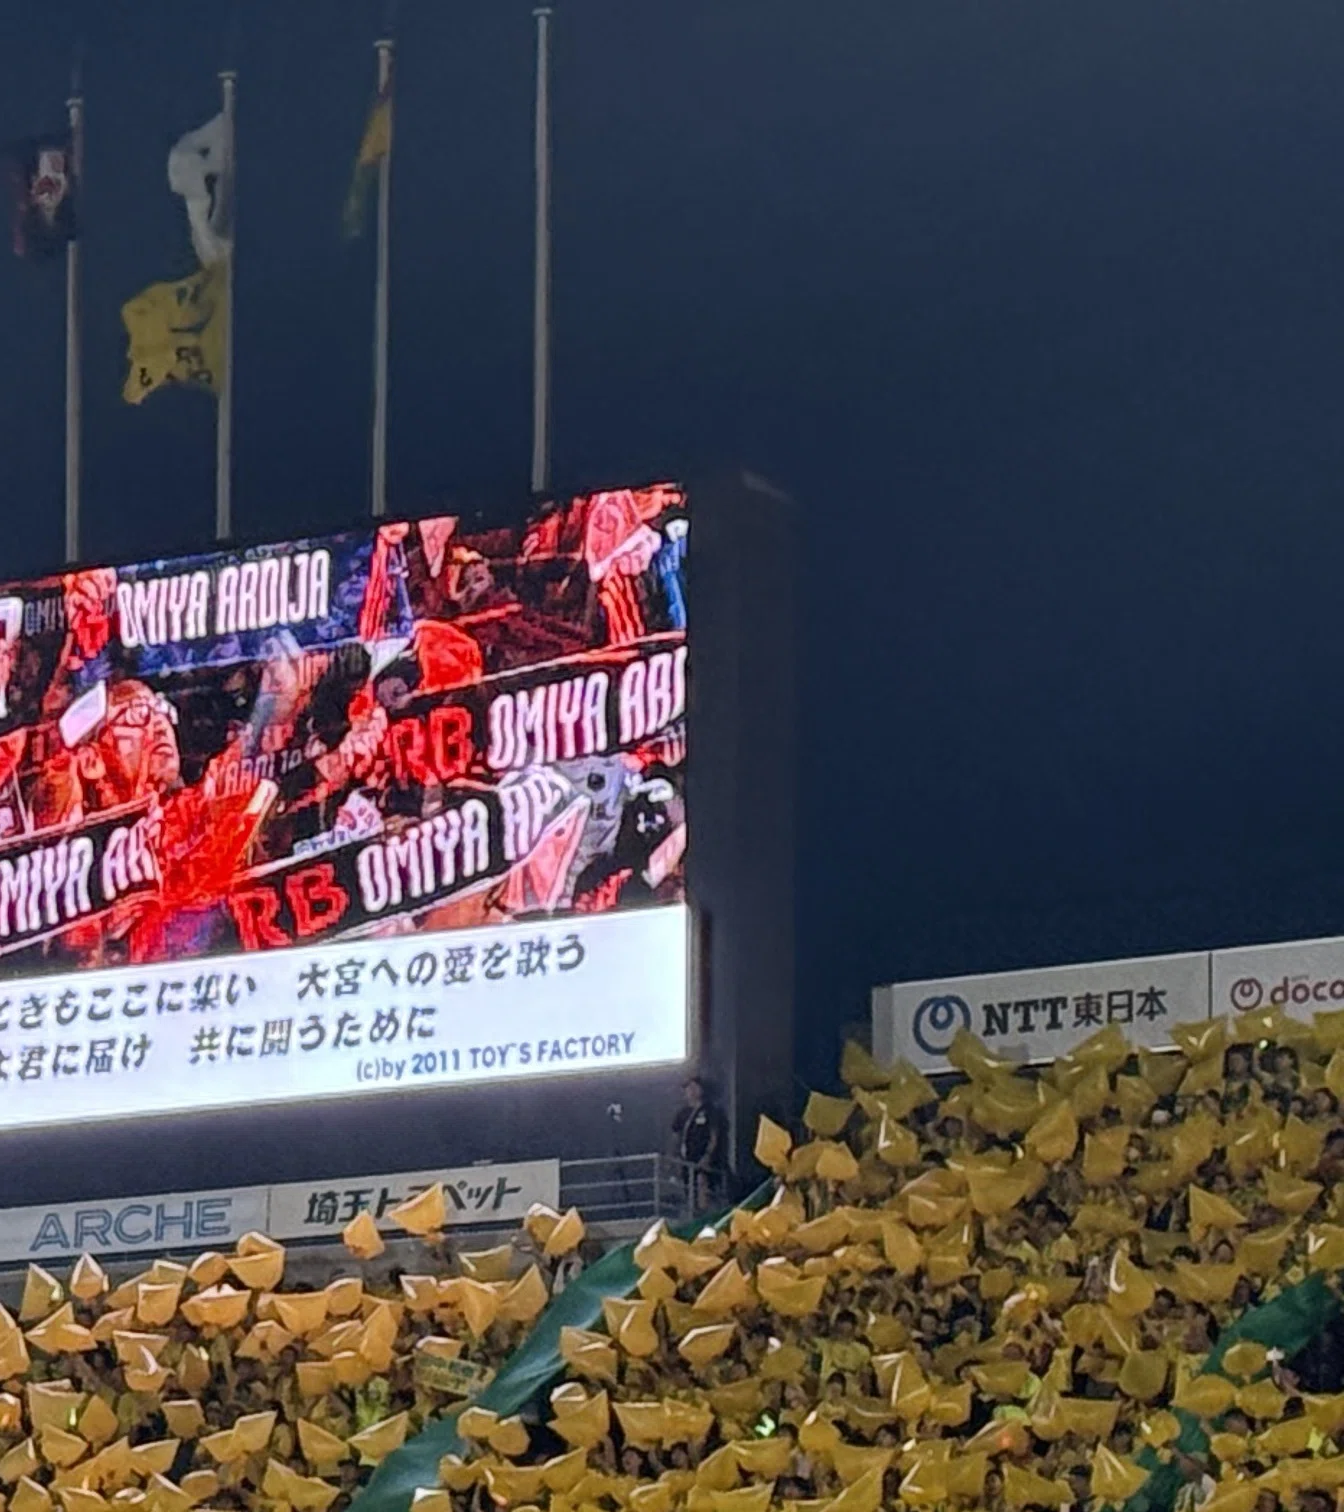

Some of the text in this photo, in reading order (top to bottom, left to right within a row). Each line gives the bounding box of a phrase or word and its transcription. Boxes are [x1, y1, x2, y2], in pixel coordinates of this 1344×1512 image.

[117, 549, 330, 648] OMIYA ARDIJA
[487, 671, 609, 769] OMIYA
[226, 862, 349, 951] RB
[357, 799, 490, 912] OMIYA
[297, 934, 586, 1001] 大宮への愛を歌う
[190, 1007, 437, 1065] 共に闘うために
[982, 986, 1169, 1037] NTT東日本
[356, 1057, 407, 1082] (c)by
[412, 1048, 461, 1073] 2011
[537, 1032, 637, 1061] FACTORY
[29, 1197, 232, 1251] ARCHE
[303, 1177, 522, 1226] 埼玉トペット
